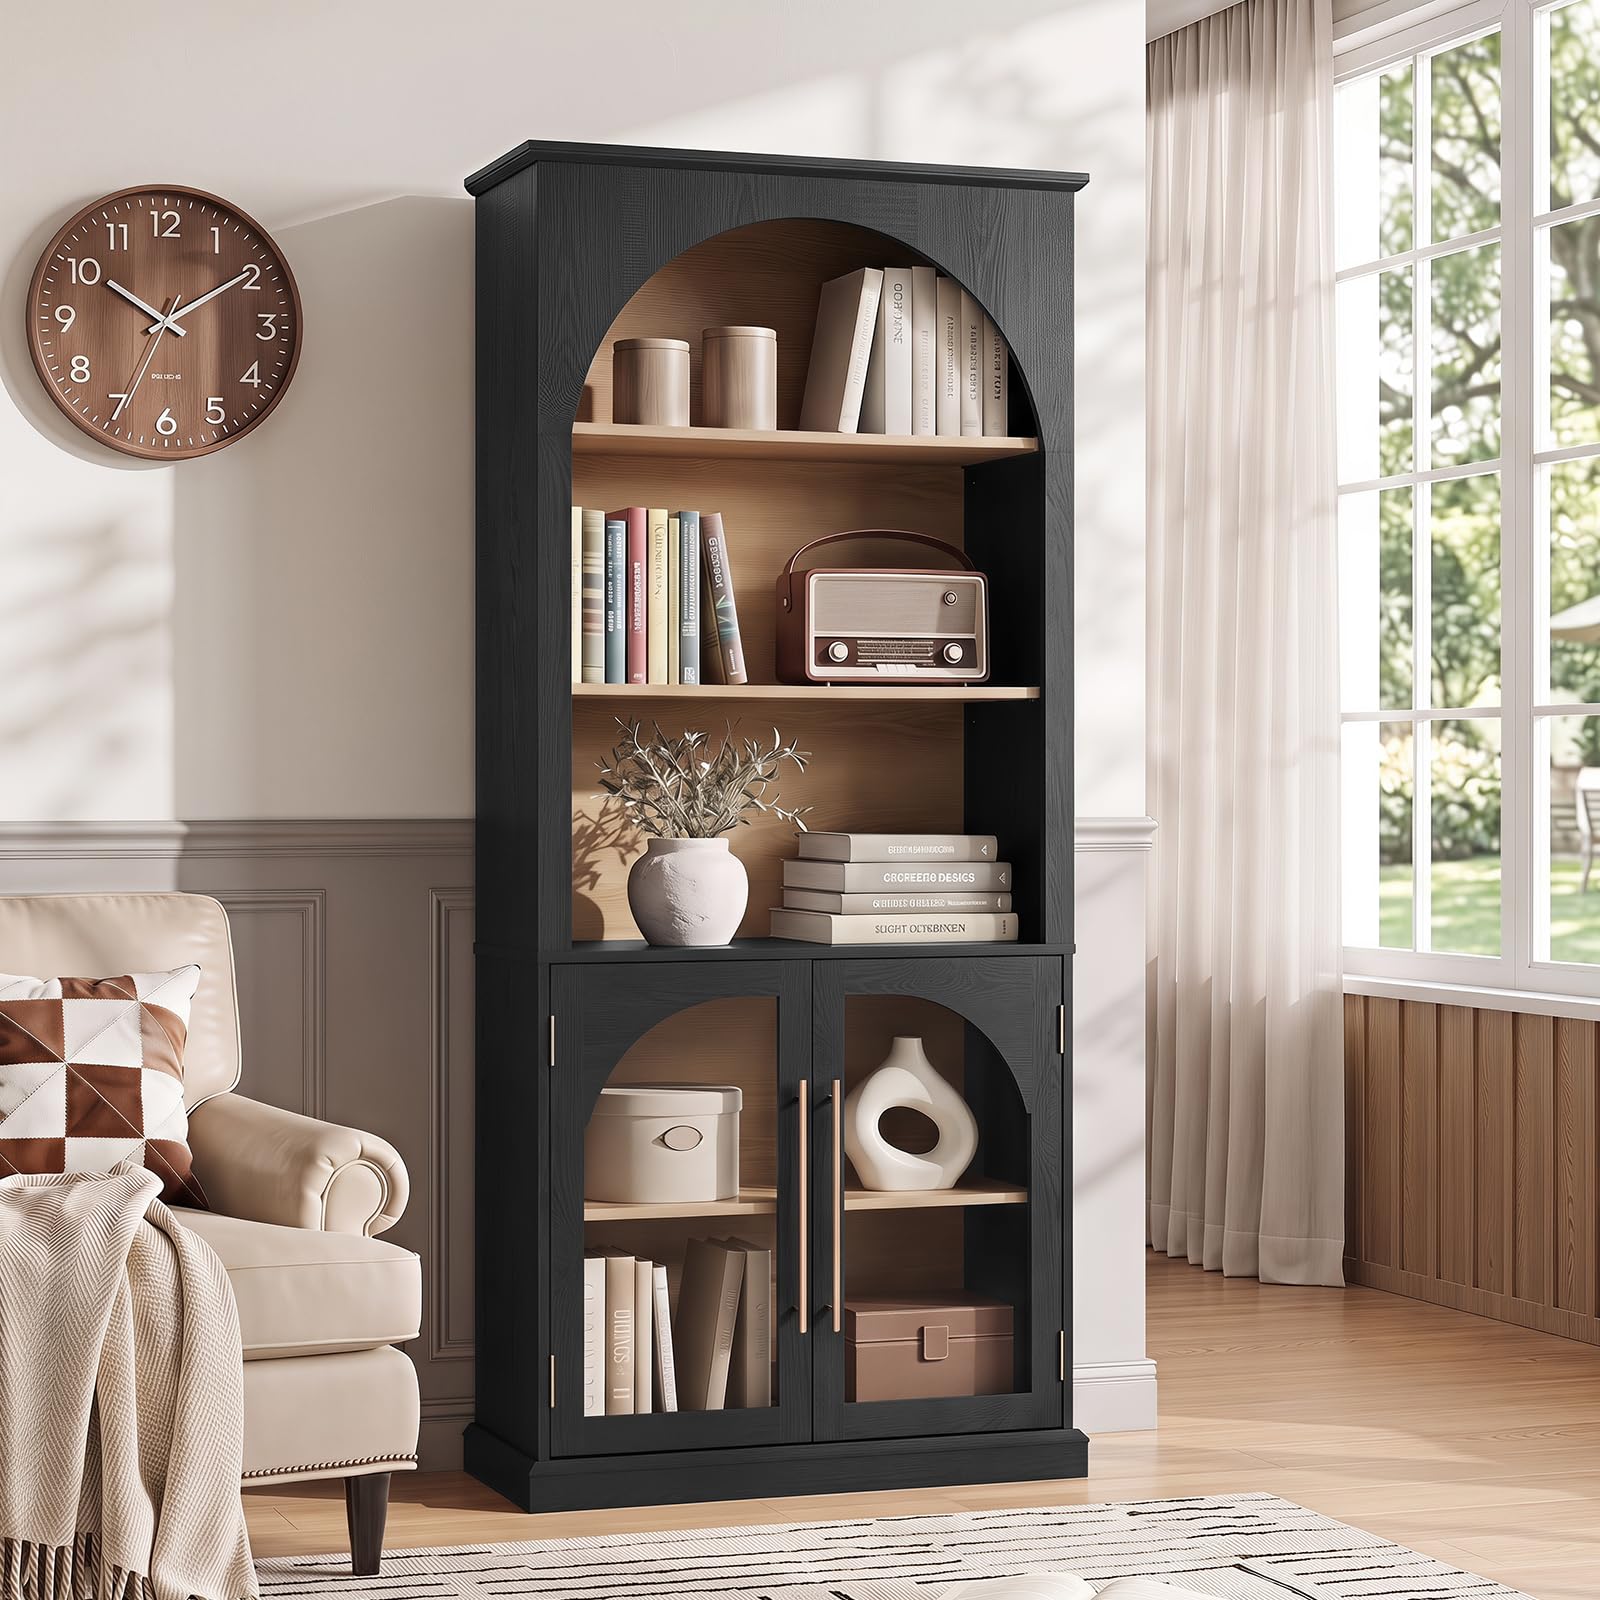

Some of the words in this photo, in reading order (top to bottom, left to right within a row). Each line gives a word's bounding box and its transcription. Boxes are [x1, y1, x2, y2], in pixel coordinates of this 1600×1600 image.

[106, 223, 129, 251] 11
[150, 210, 182, 238] 12
[210, 227, 221, 255] 1
[67, 257, 101, 286] 10
[241, 263, 261, 290] 2
[54, 304, 76, 333] 9
[255, 313, 277, 341] 3
[70, 354, 91, 384] 8
[239, 360, 262, 388] 4
[108, 393, 128, 421] 7
[205, 396, 226, 425] 5
[155, 407, 177, 436] 6
